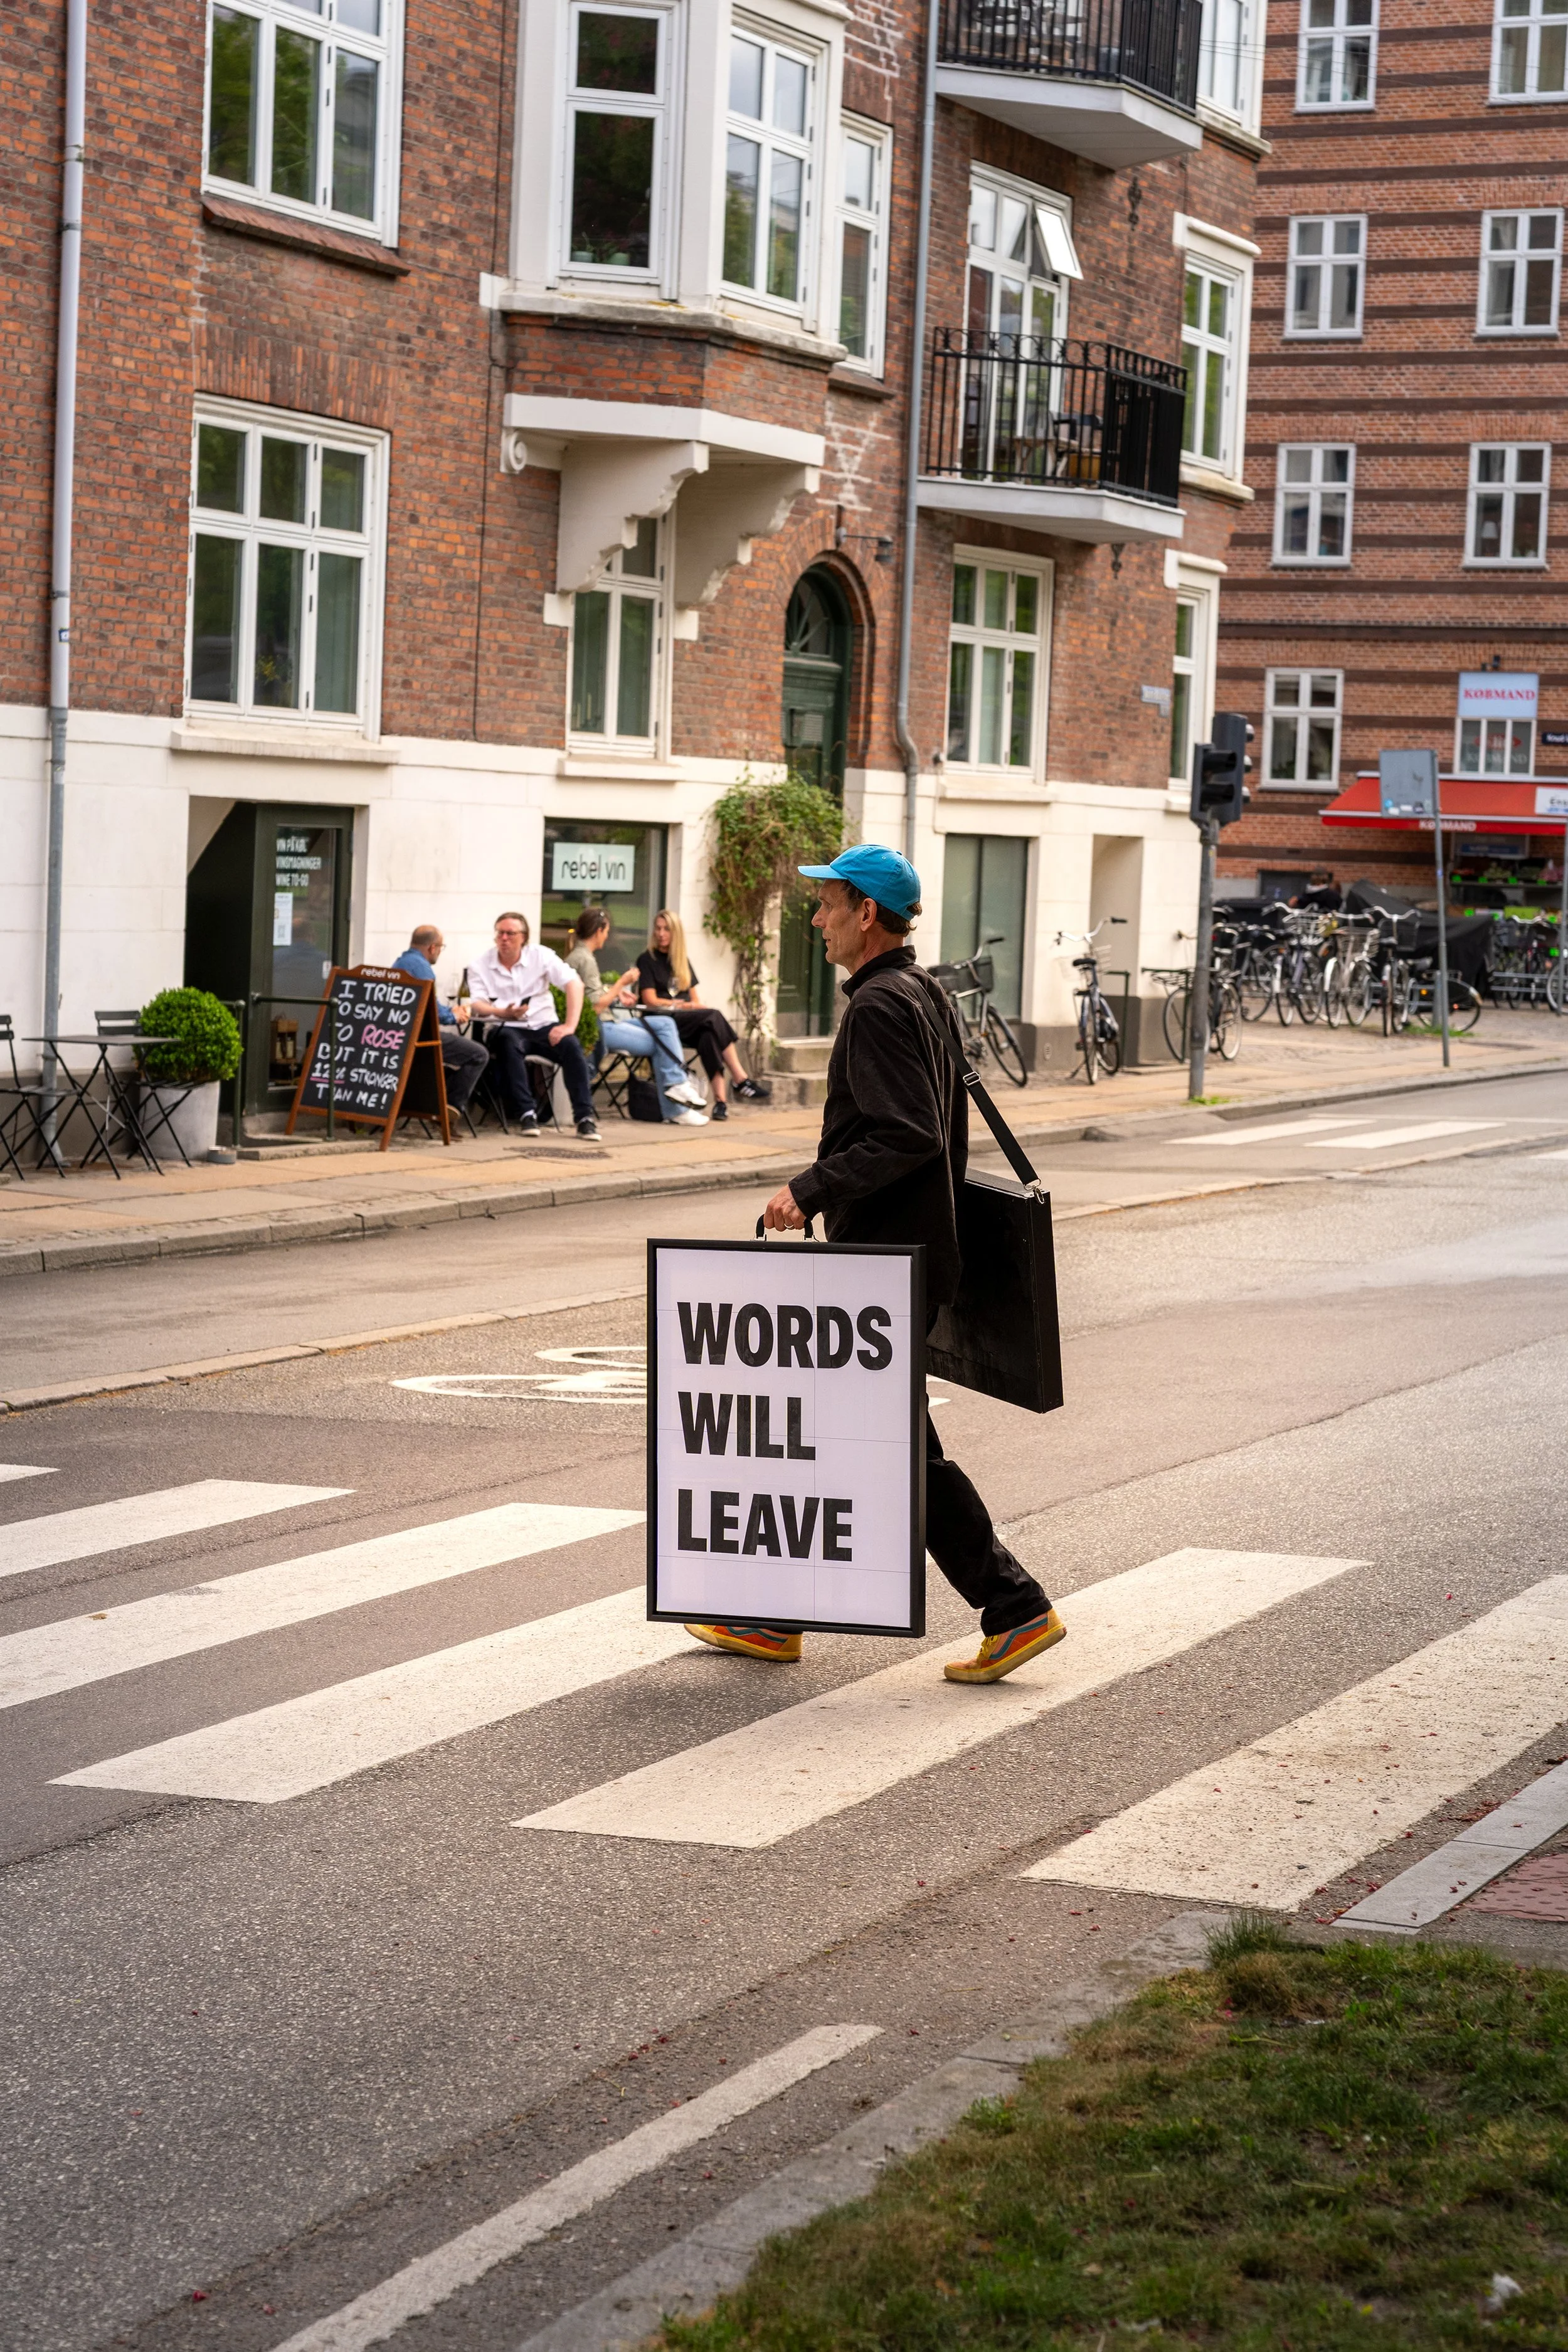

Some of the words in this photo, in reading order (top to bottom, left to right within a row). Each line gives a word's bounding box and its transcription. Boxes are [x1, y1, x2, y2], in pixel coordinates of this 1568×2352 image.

[1463, 689, 1535, 701] KØBMAND
[561, 854, 601, 879] rebel
[605, 862, 626, 881] vin
[361, 967, 386, 978] rebel
[387, 972, 401, 980] vin
[338, 980, 358, 999] I
[337, 1000, 351, 1016] O
[353, 1003, 384, 1021] SAY
[387, 1008, 411, 1025] NO
[316, 1083, 352, 1102] TAN
[349, 1067, 400, 1093] STRONGER
[677, 1302, 893, 1371] WORDS
[677, 1392, 816, 1461] WILL
[677, 1489, 852, 1562] LEAVE
